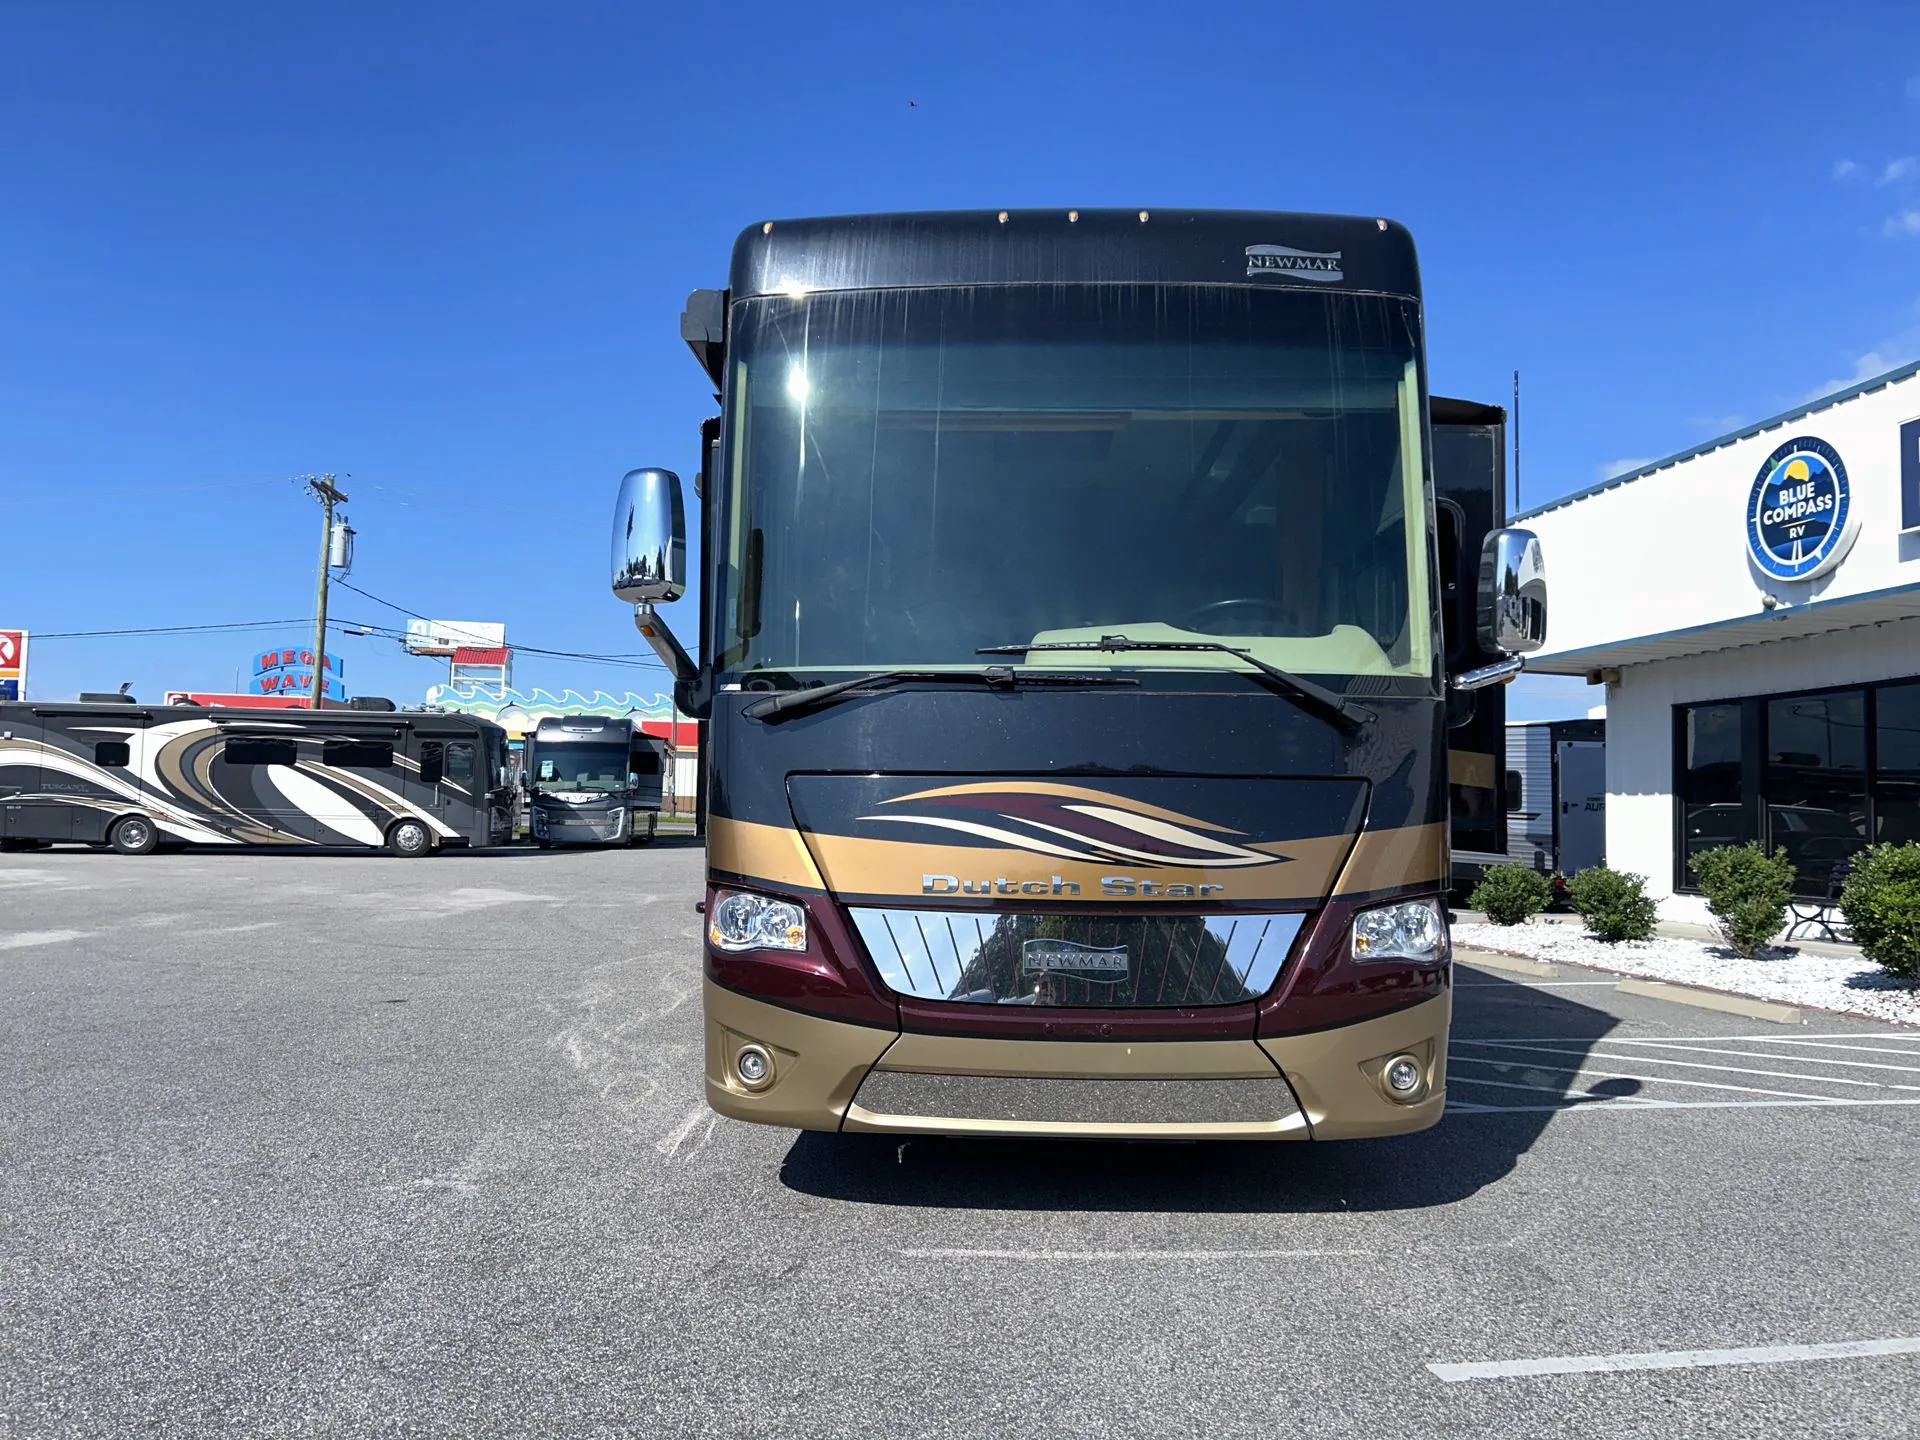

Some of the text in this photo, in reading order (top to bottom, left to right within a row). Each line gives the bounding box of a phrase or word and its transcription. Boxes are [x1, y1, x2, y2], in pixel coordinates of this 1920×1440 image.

[1248, 255, 1341, 271] NEWMAR
[1779, 481, 1815, 506] BLUE
[1763, 493, 1833, 526] COMPASS
[1789, 525, 1806, 539] RV
[922, 874, 1224, 897] Dutch Star
[1027, 953, 1122, 968] NEWMAR
